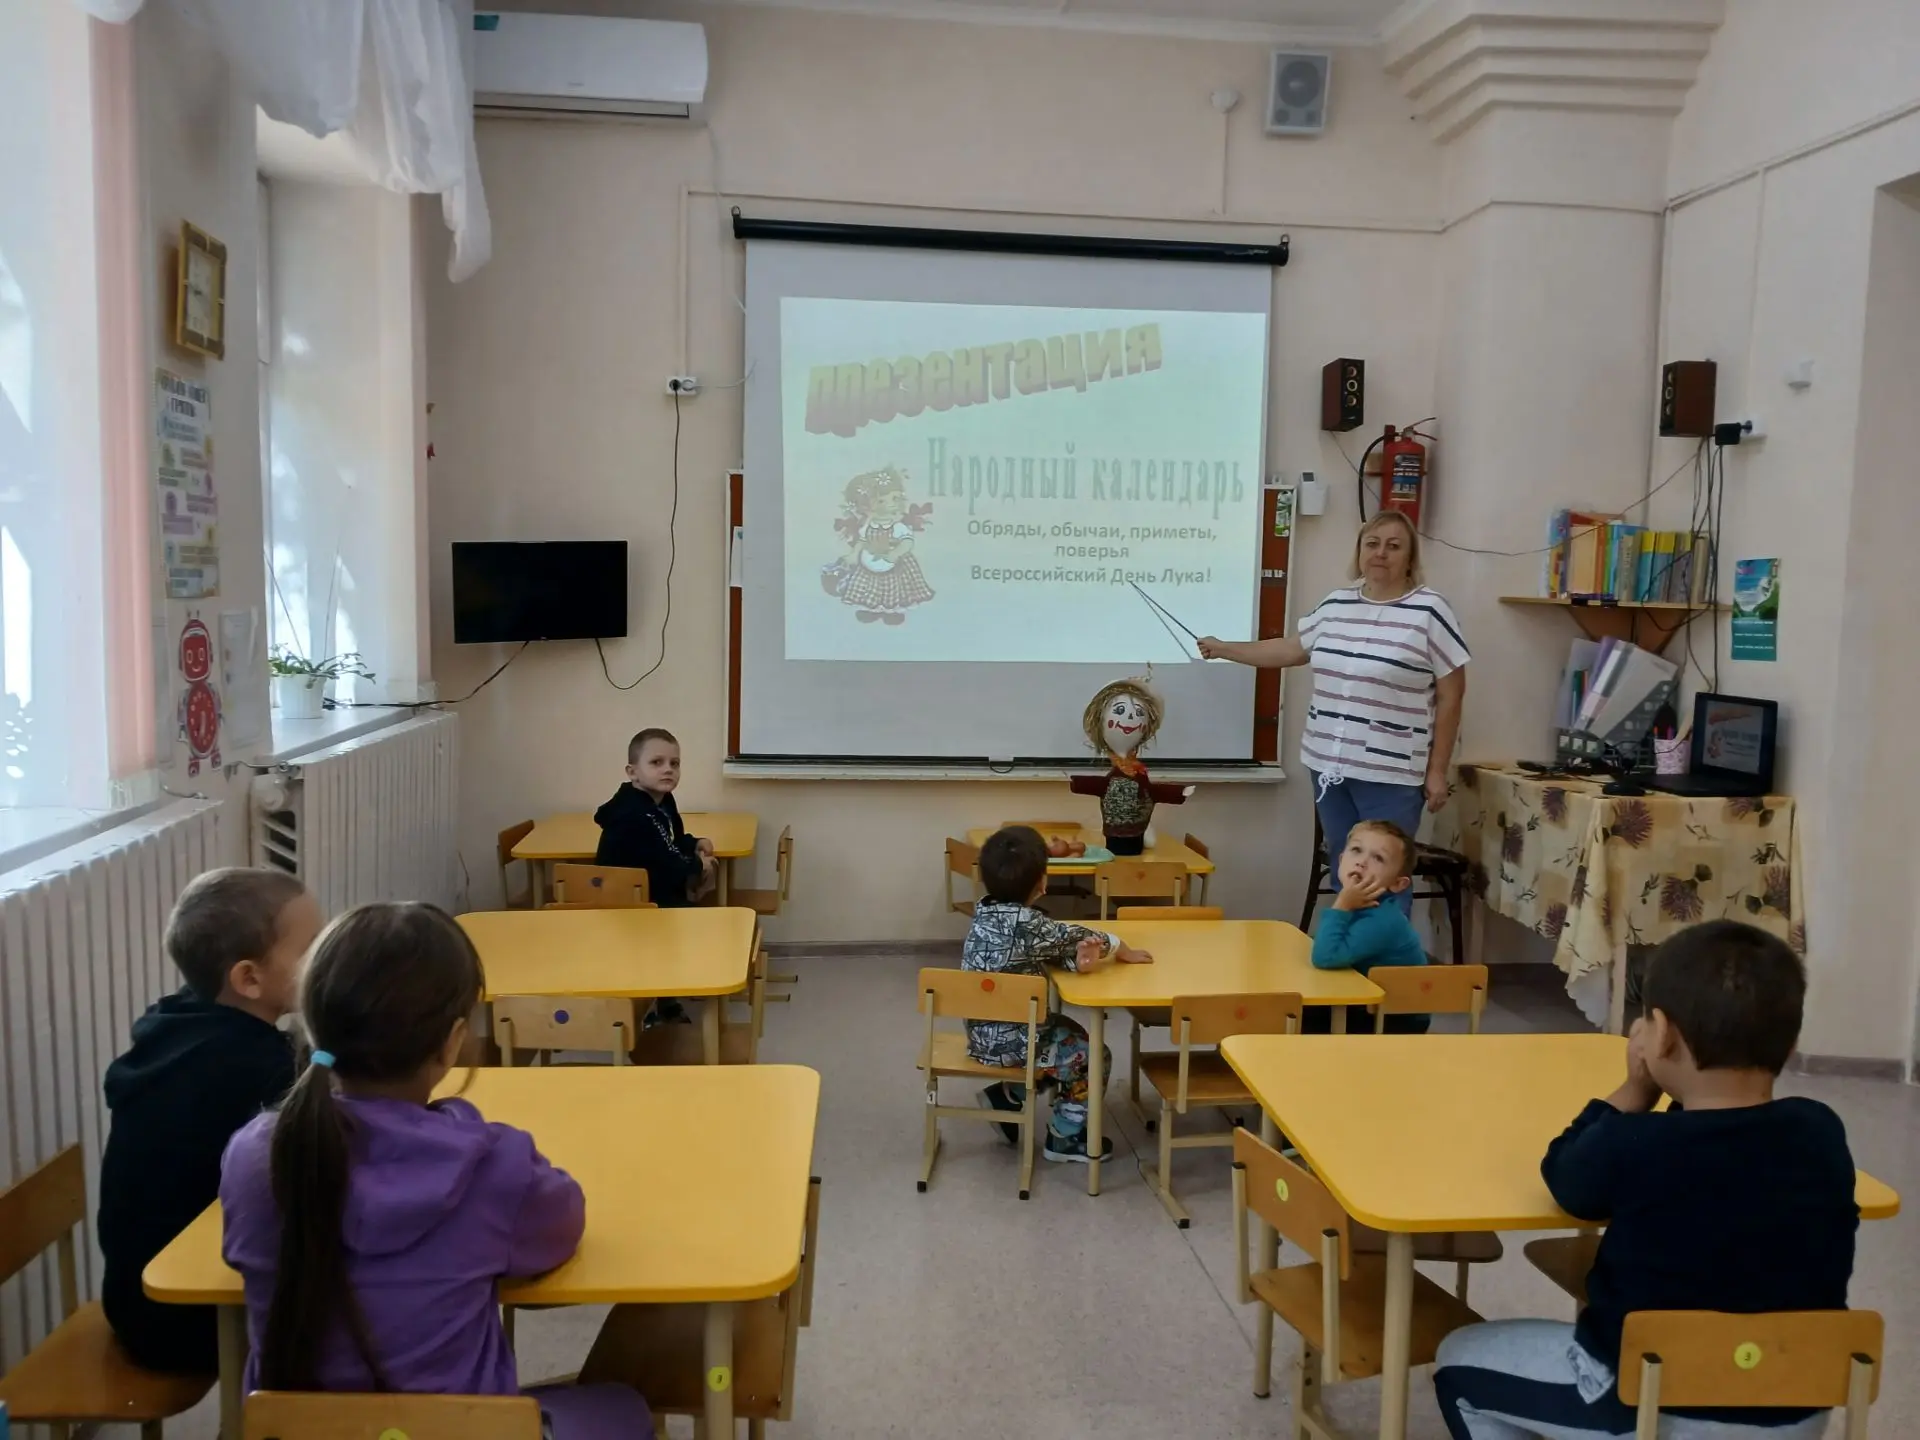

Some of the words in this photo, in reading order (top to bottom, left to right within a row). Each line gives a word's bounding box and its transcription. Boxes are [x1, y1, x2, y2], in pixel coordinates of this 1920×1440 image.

[927, 437, 1078, 516] Народный
[1092, 455, 1244, 519] календарь
[967, 520, 1047, 539] Обряды,
[1050, 522, 1126, 541] обычаи,
[1130, 526, 1217, 541] приметы,
[1055, 545, 1130, 561] поверья
[970, 565, 1106, 583] Всероссийский
[1110, 569, 1156, 585] День
[1161, 569, 1212, 585] Лука!
